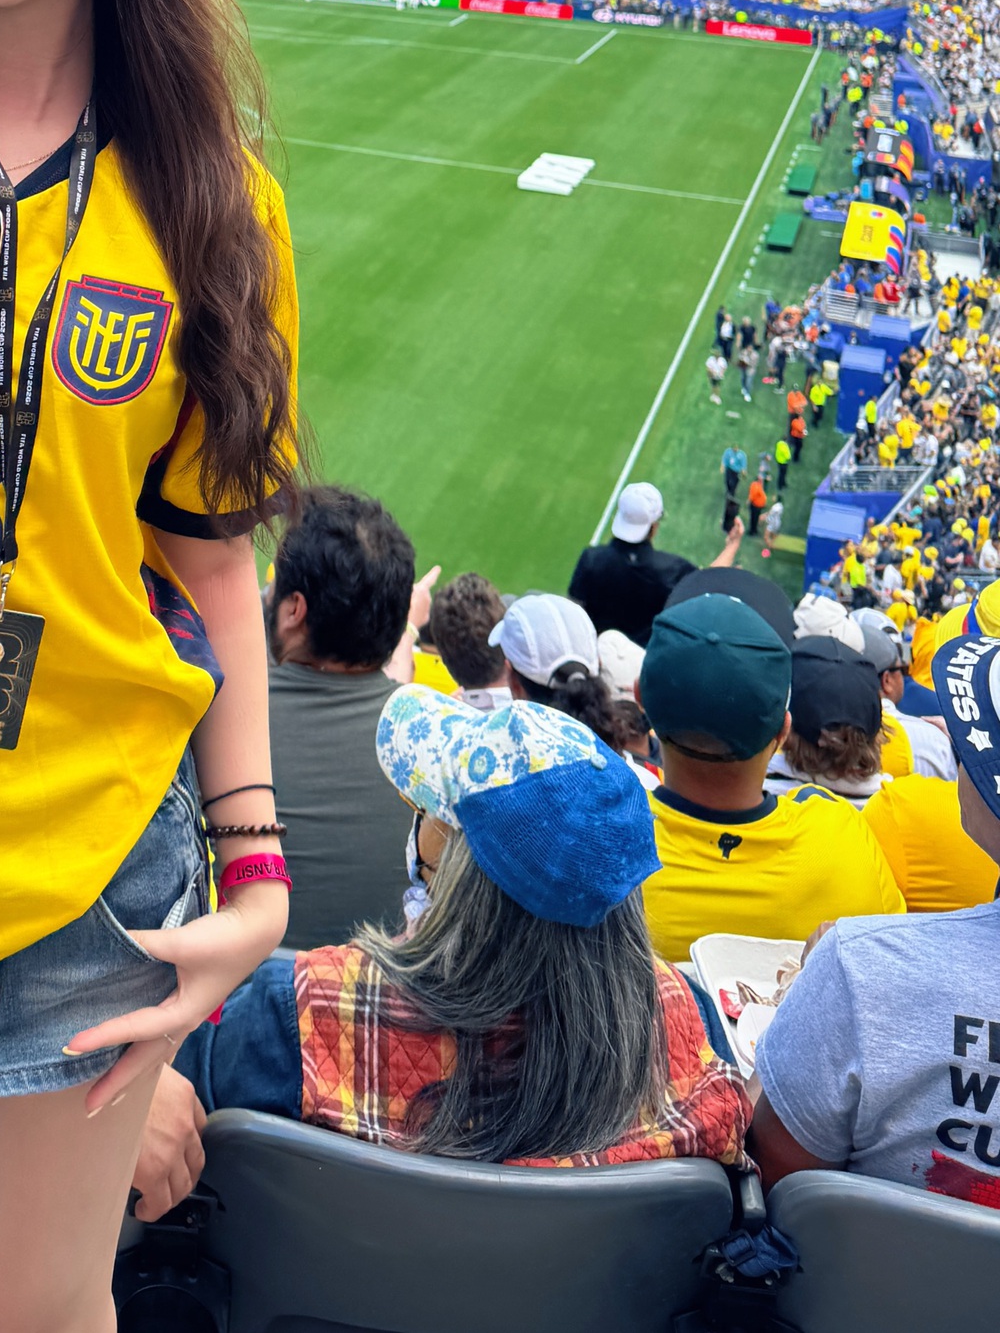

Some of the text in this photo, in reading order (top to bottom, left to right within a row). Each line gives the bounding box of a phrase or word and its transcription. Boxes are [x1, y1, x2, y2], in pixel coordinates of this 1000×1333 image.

[722, 21, 777, 41] Lenovo
[78, 161, 87, 183] WORLD
[32, 327, 41, 341] FIFA
[29, 342, 38, 366] WORLD
[27, 366, 35, 380] CUP
[19, 433, 27, 448] FIFA
[16, 449, 24, 472] WORLD
[946, 635, 1000, 723] STATES
[235, 862, 287, 881] TRANSIT
